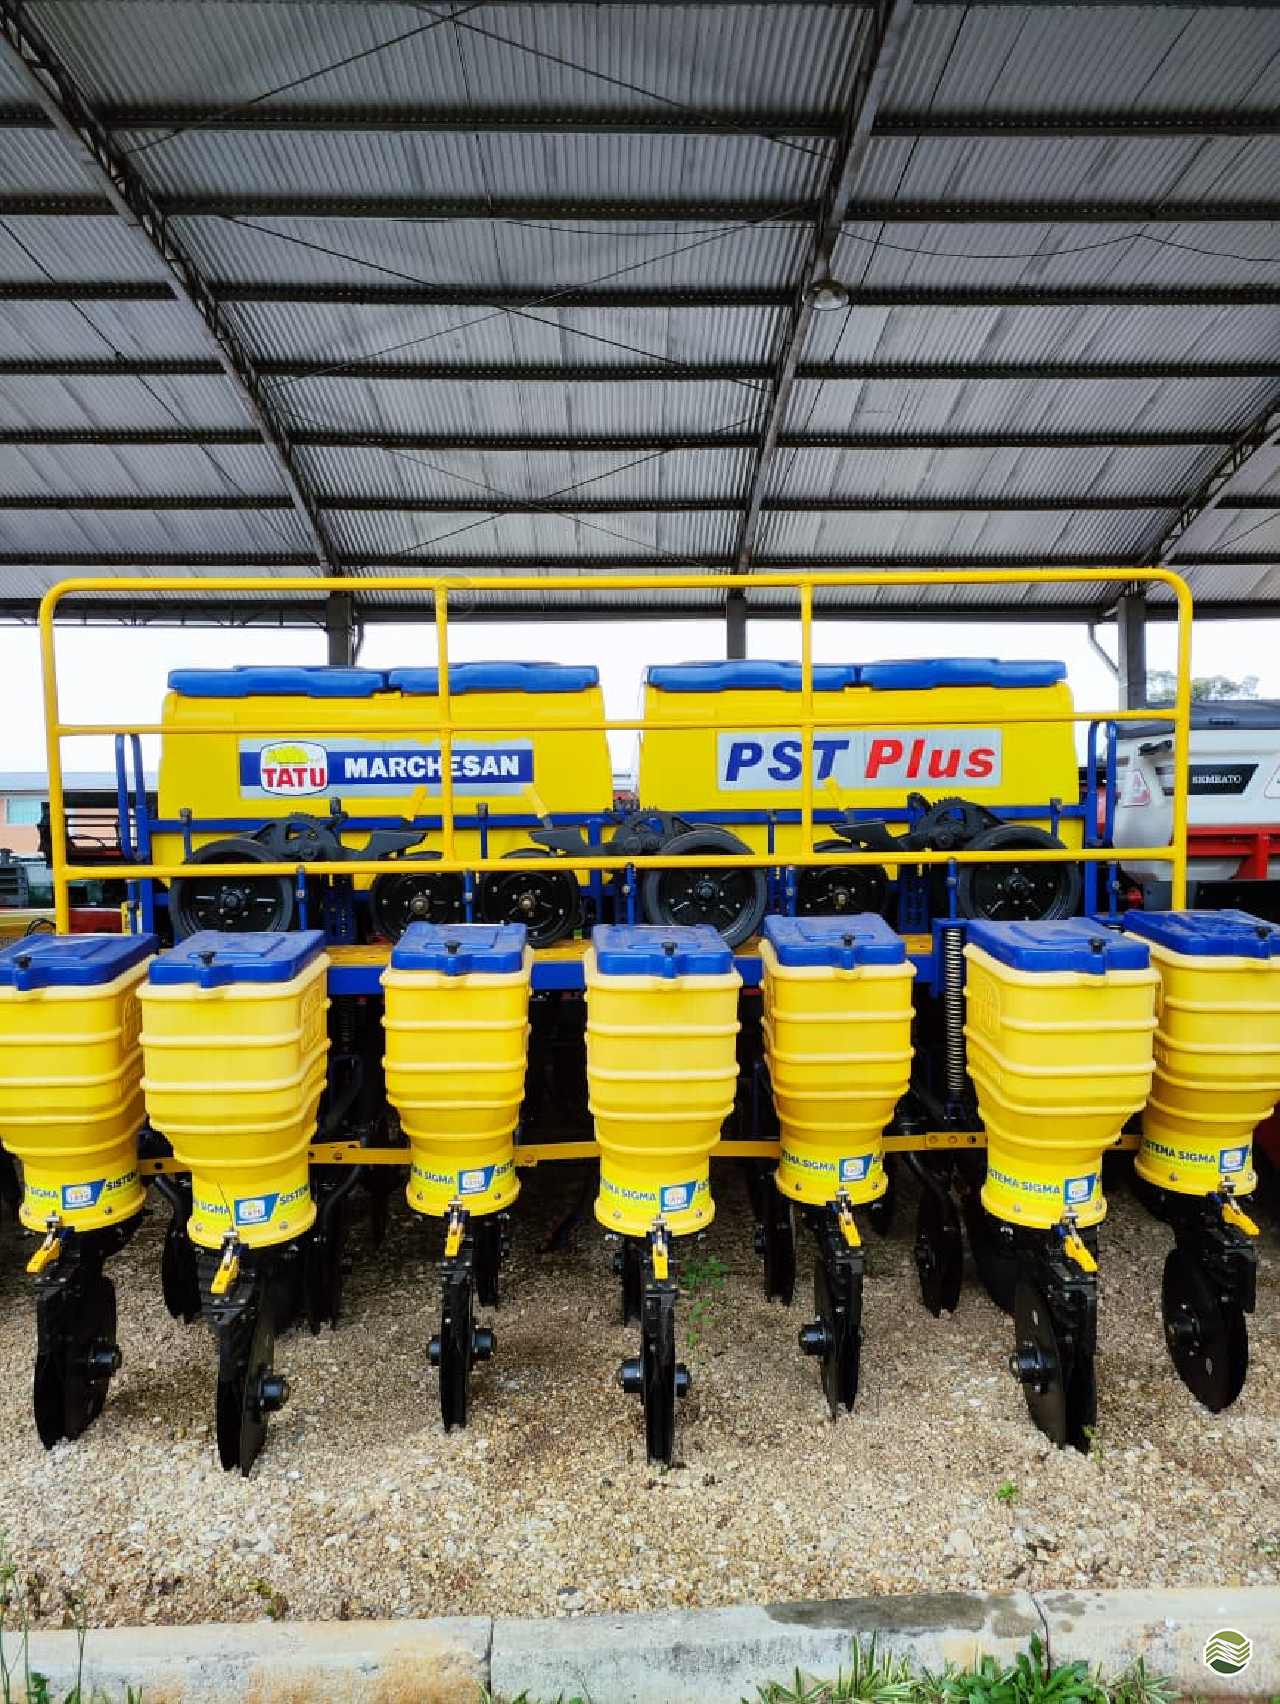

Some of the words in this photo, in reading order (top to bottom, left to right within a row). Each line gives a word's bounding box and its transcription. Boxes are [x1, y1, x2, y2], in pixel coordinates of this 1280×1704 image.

[345, 755, 519, 777] MARCHESAN
[726, 740, 849, 781] PST
[865, 738, 995, 778] Plus
[261, 767, 326, 787] TATU
[1178, 1150, 1215, 1164] SIGMA
[802, 1160, 836, 1171] SIGMA
[425, 1172, 454, 1184] SIGMA
[1021, 1181, 1060, 1195] SIGMA
[622, 1190, 656, 1201] SIGMA
